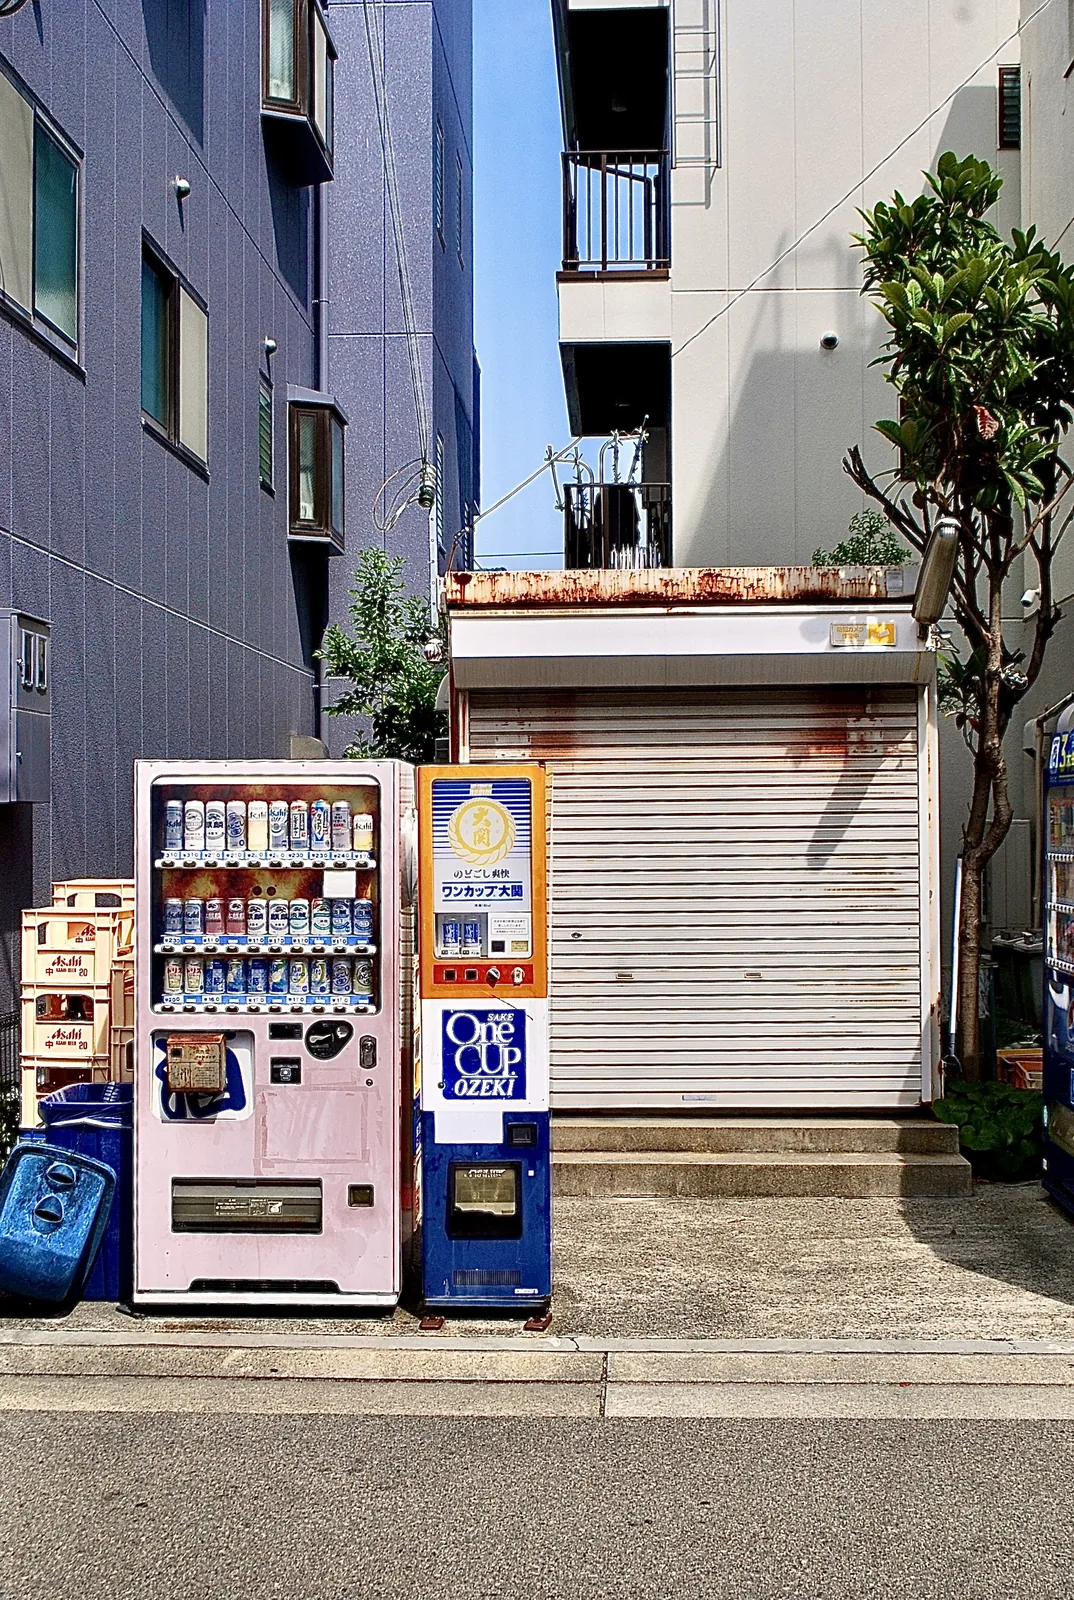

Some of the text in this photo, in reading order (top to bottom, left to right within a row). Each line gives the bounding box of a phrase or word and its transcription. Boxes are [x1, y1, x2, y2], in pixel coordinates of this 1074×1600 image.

[454, 868, 510, 879] のどごし爽快
[441, 884, 523, 898] ワンカップ大関
[52, 955, 82, 967] Asahi
[78, 968, 88, 977] 20
[487, 1013, 515, 1022] SAKE
[52, 1027, 82, 1040] Asahi
[446, 1012, 515, 1045] One
[78, 1041, 88, 1050] 20
[454, 1079, 516, 1097] OZEKI
